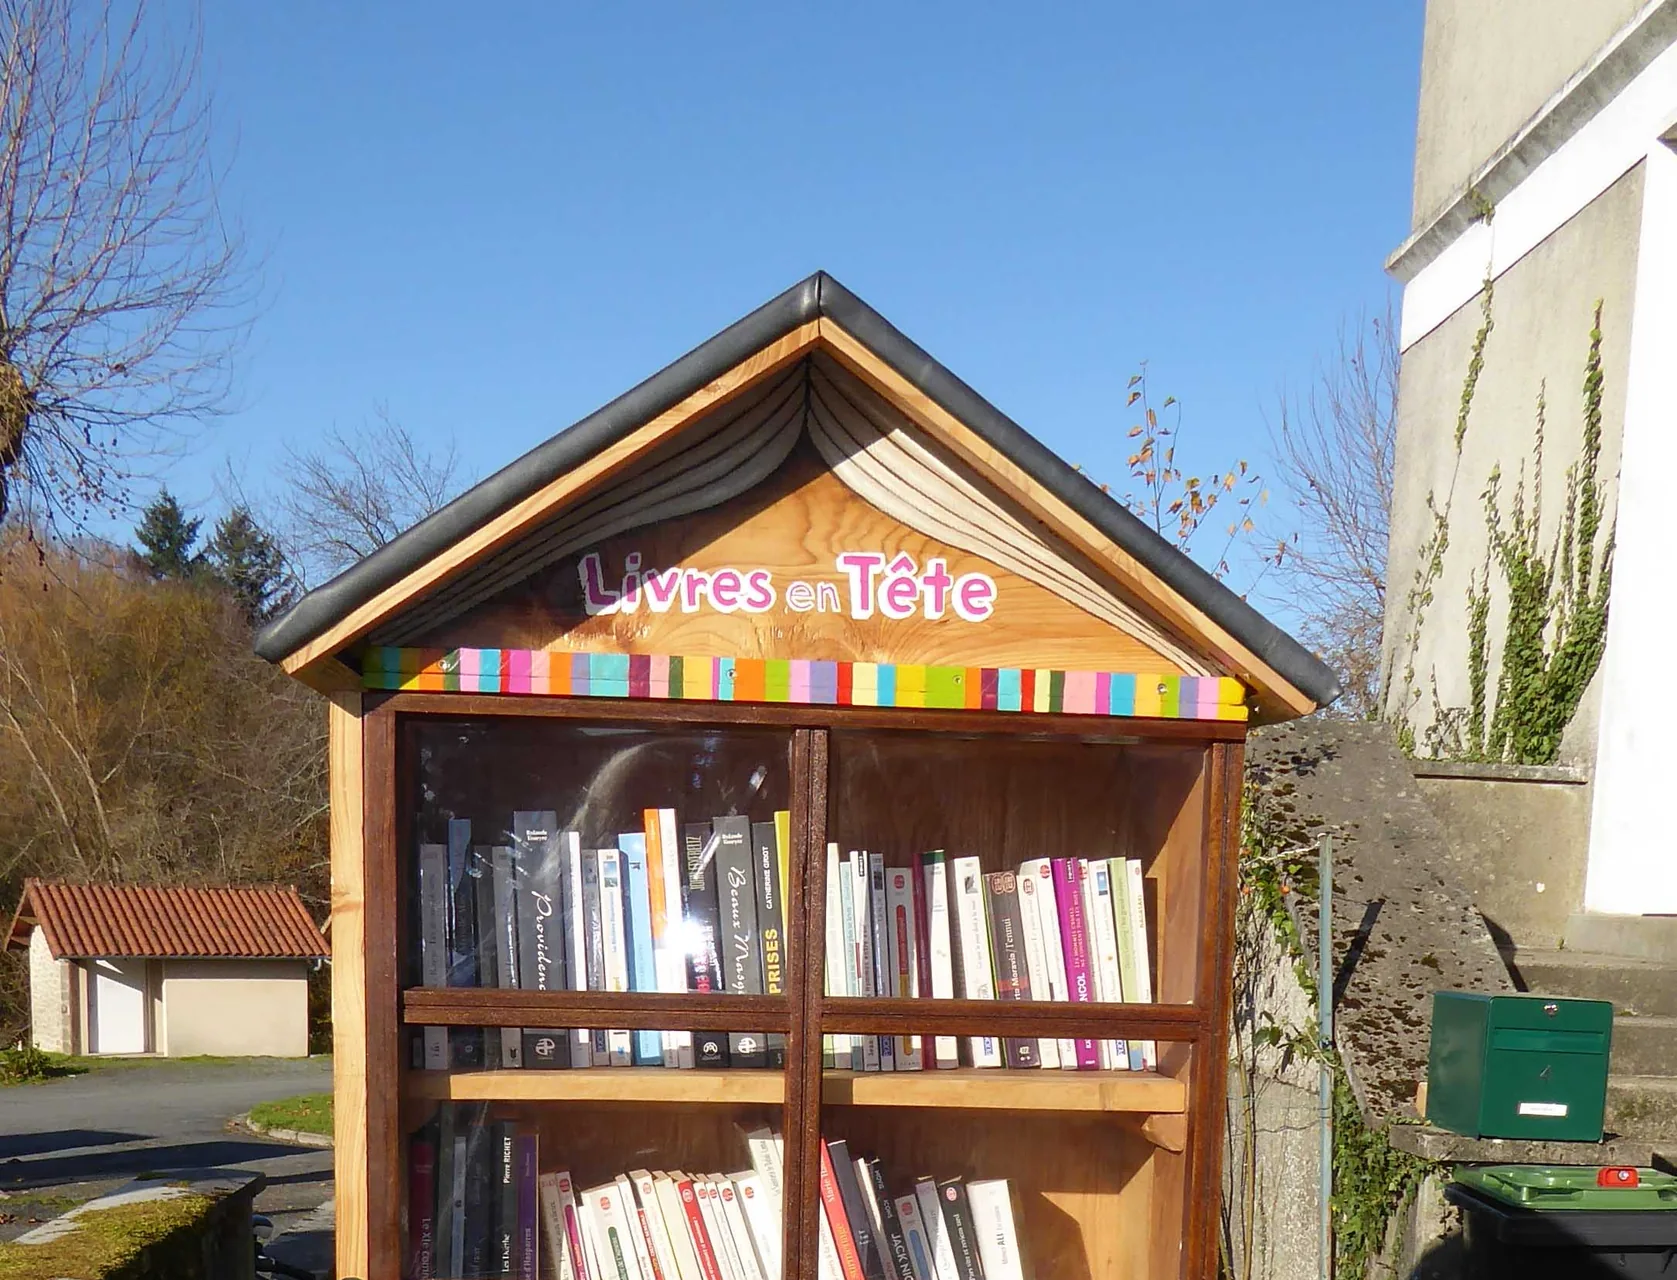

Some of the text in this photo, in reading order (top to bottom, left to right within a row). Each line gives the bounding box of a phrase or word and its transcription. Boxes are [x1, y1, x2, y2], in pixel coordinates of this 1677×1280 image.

[579, 550, 996, 621] Livres en Tête
[763, 869, 772, 909] CATHERINE
[768, 929, 782, 994] PRISES
[502, 1136, 511, 1162] RICHET
[889, 1231, 907, 1261] JACK
